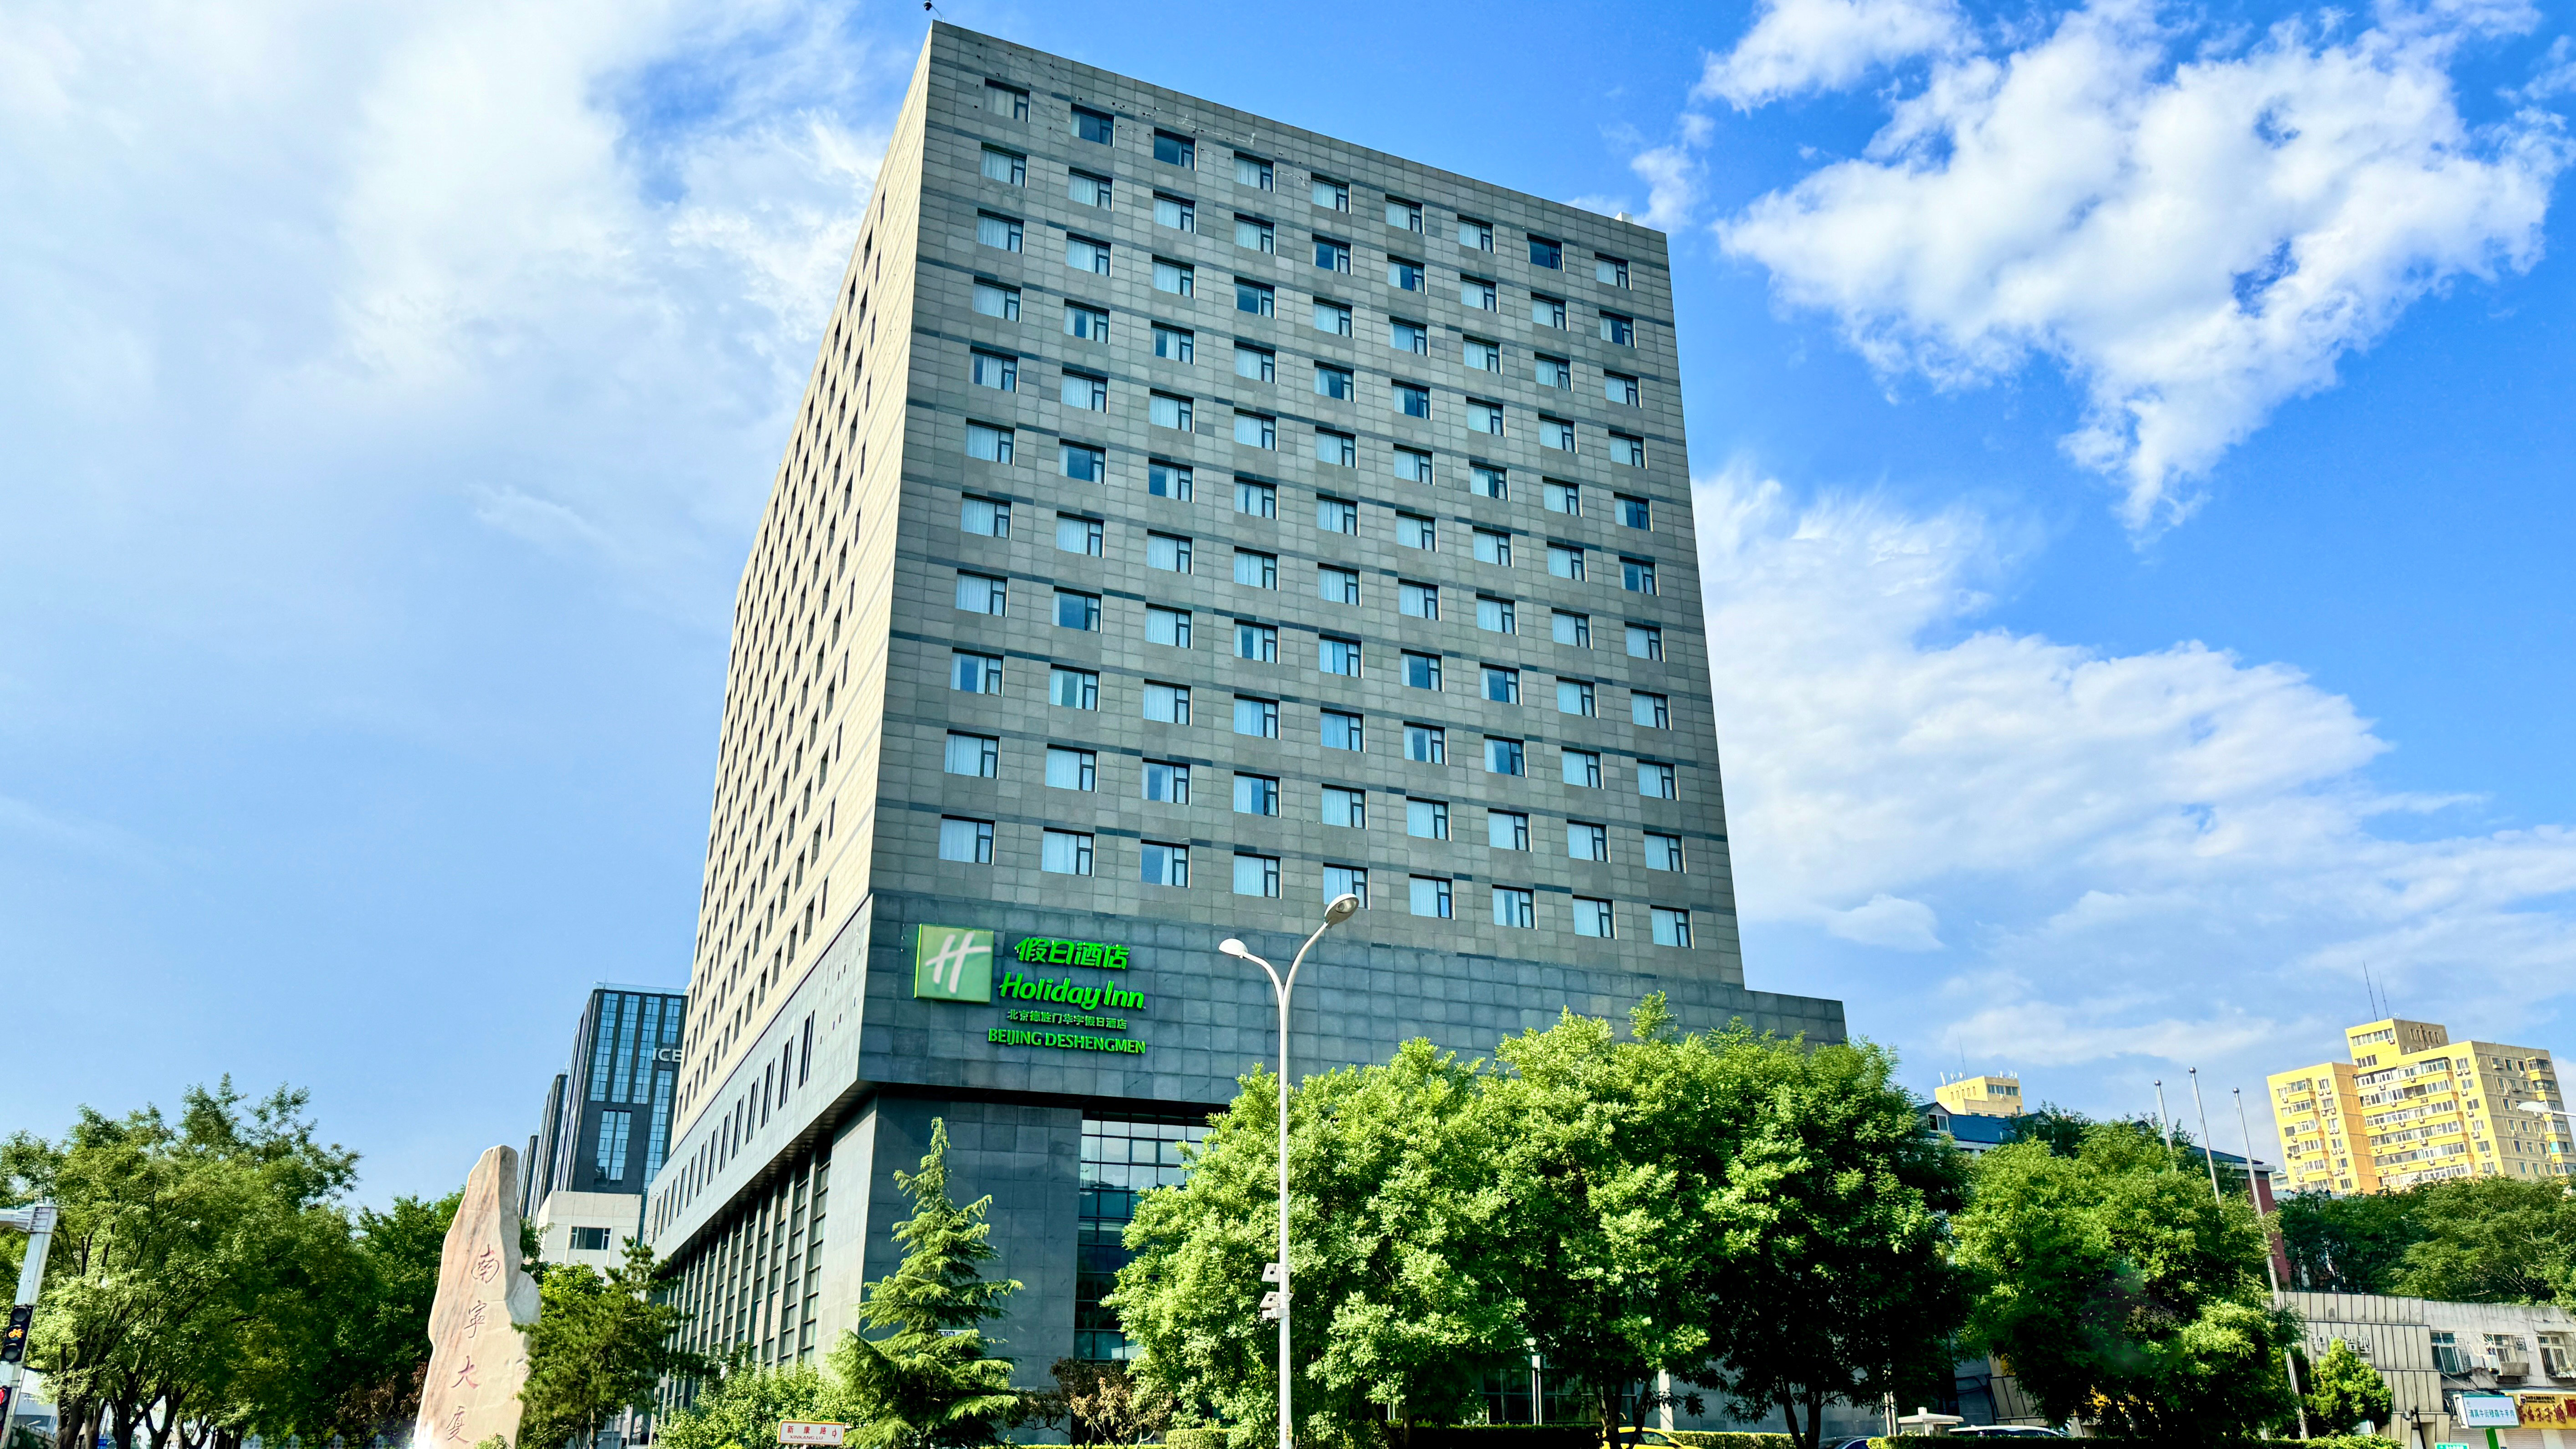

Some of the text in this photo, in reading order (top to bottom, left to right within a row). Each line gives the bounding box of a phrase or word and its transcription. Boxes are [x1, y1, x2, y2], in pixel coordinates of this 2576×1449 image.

[1015, 937, 1130, 969] 假日酒店
[999, 972, 1145, 1010] Holiday Inn
[1007, 1009, 1127, 1029] 北京德胜门华宇假日酒店
[988, 1028, 1146, 1054] BEIJING DESHENGMEN
[2312, 1334, 2373, 1353] 护造型
[787, 1425, 827, 1434] 新康路
